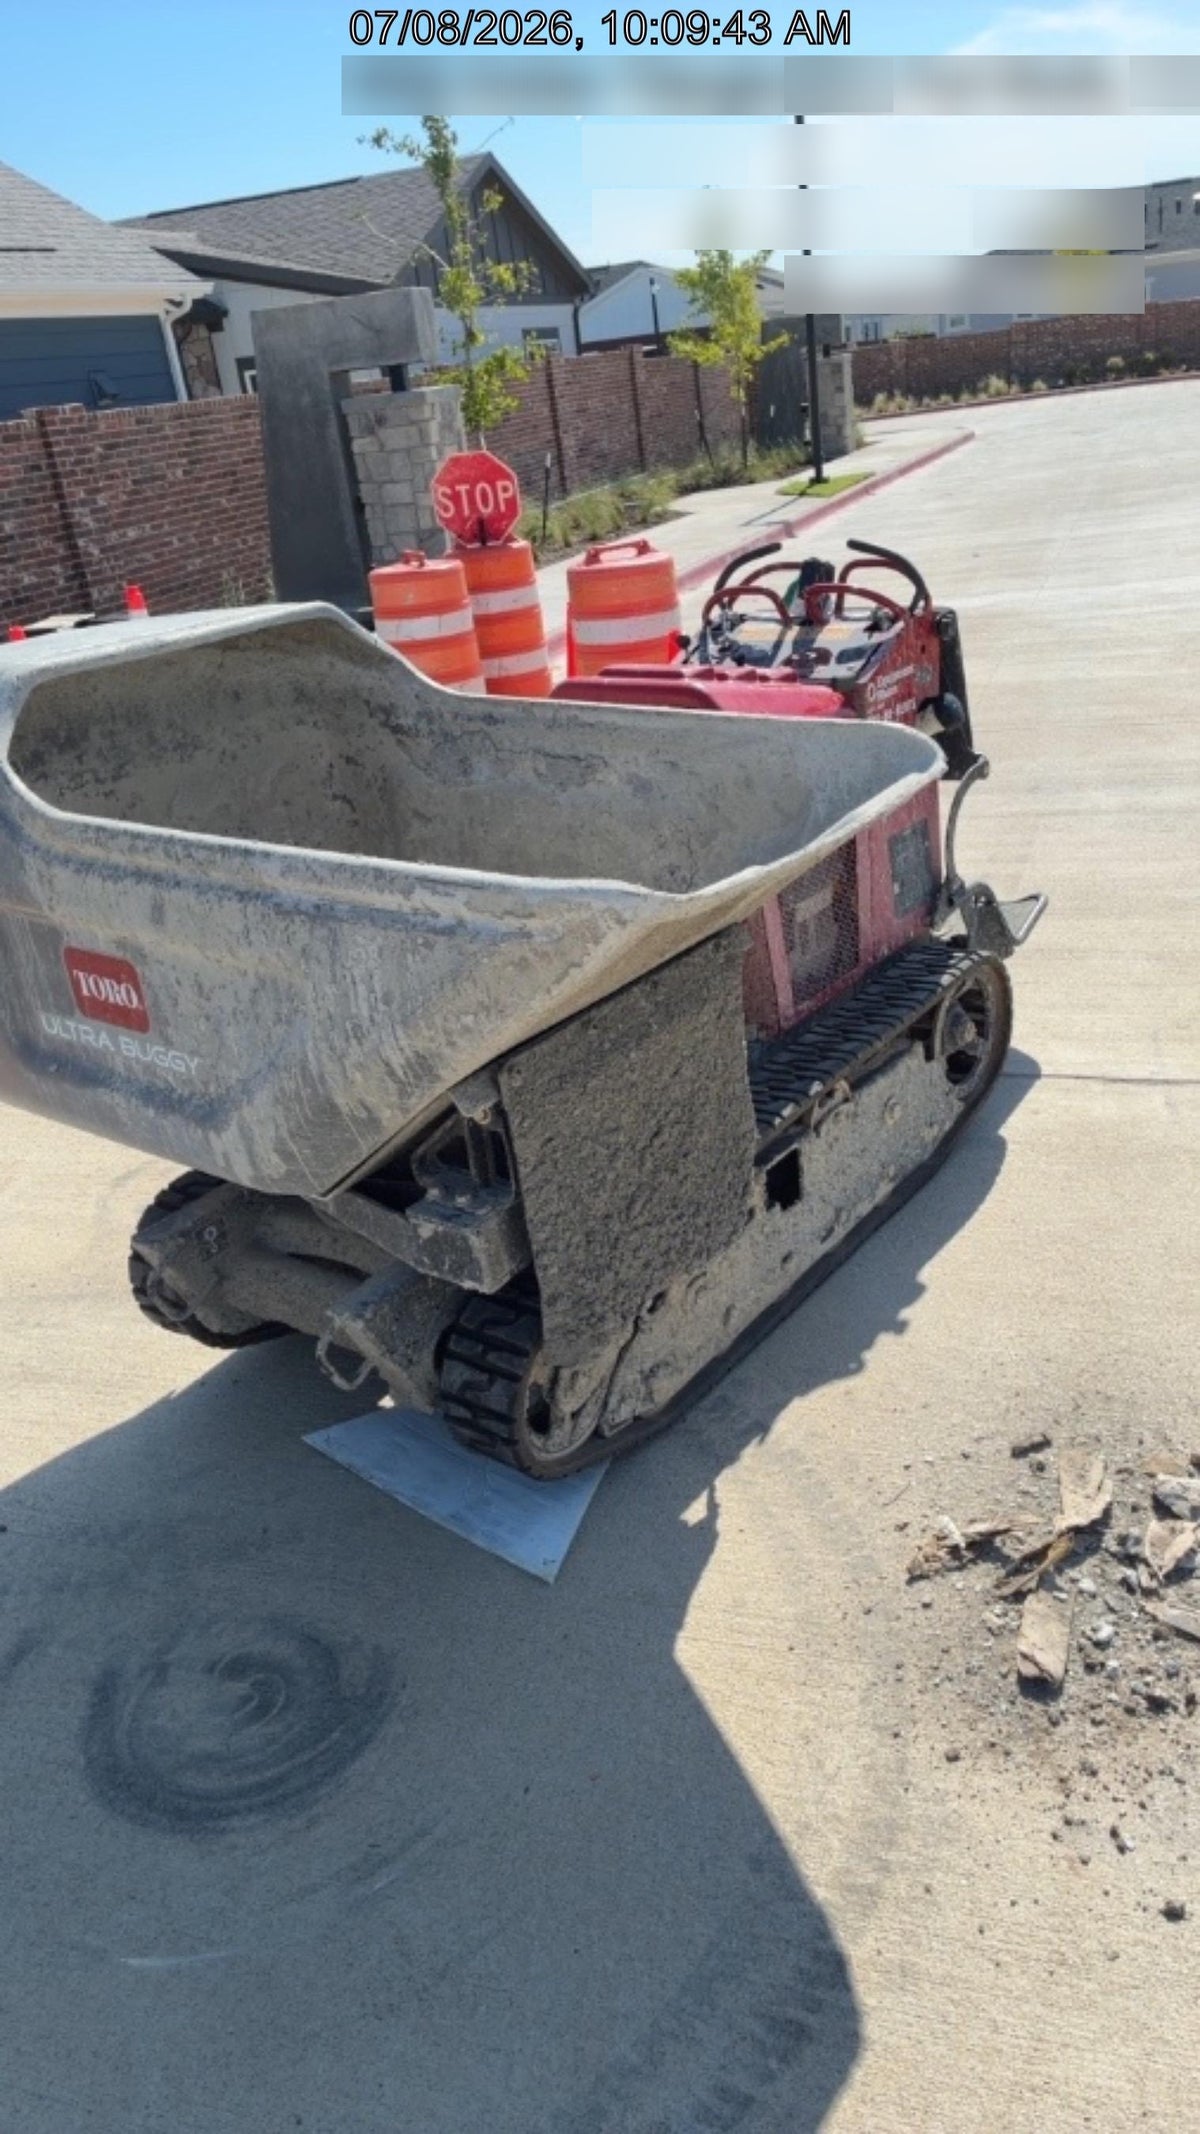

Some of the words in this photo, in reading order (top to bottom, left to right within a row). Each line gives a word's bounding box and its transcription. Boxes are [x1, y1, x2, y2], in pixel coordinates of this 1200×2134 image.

[435, 480, 515, 519] STOP
[73, 969, 140, 1009] TORO
[40, 1011, 115, 1051] ULTRA
[119, 1035, 200, 1075] BUGGY
